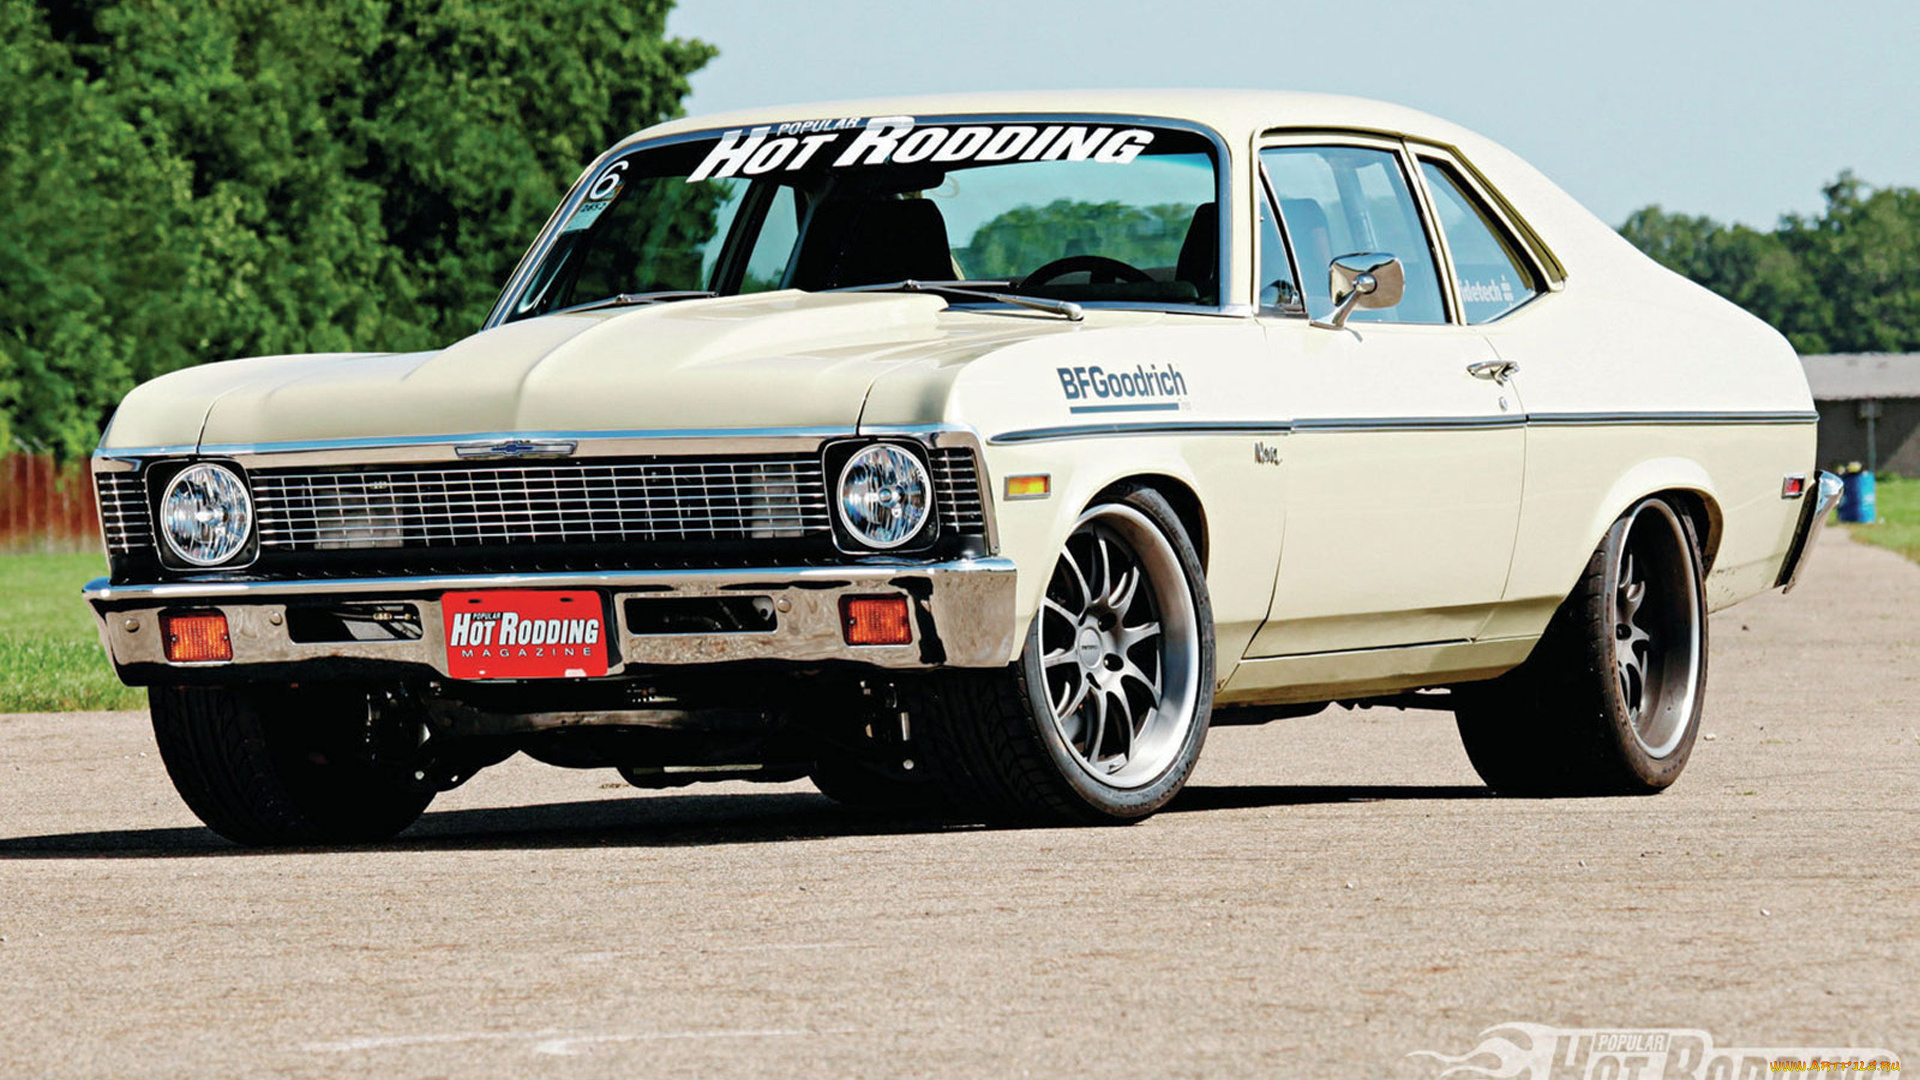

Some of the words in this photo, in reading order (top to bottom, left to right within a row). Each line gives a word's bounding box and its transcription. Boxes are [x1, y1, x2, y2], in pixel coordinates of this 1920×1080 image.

[777, 117, 862, 136] POPULAR
[590, 160, 629, 200] 6
[1459, 279, 1503, 302] idetech
[1056, 363, 1188, 400] BFGoodrich
[472, 612, 501, 620] POPULAR
[461, 647, 592, 657] MAGAZINE
